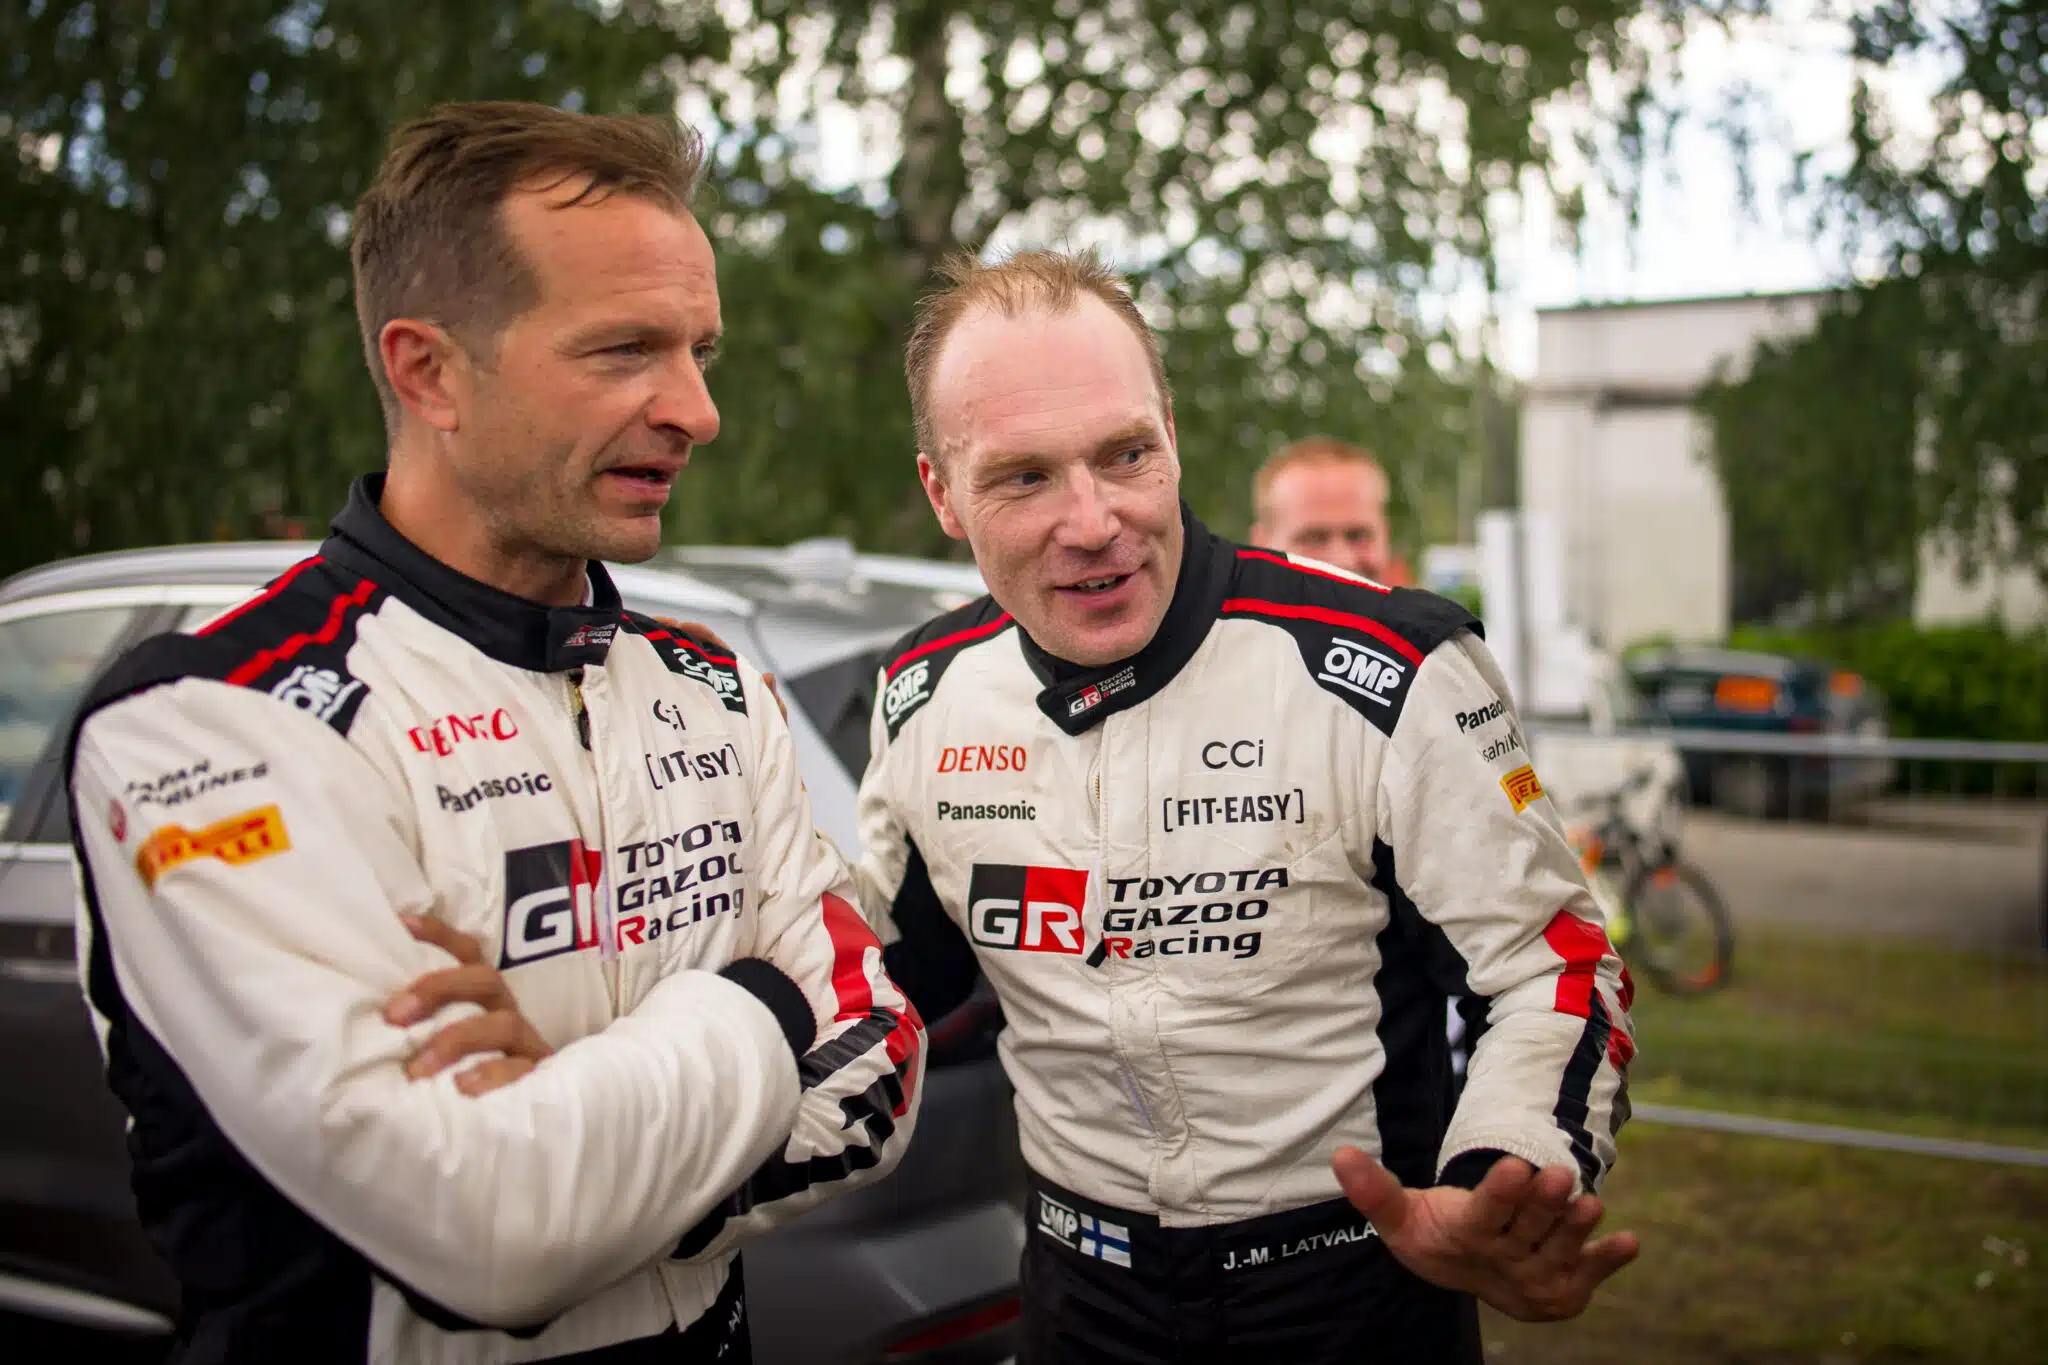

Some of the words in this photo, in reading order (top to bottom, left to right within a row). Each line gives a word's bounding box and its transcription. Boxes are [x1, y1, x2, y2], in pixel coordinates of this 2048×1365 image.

[1097, 665, 1135, 686] TOYOTA
[1101, 672, 1134, 692] GAZOO
[1324, 647, 1400, 694] OMP
[886, 668, 929, 715] OMP
[1070, 691, 1101, 714] GR
[1102, 679, 1136, 699] Racing
[937, 745, 1027, 772] DENSO
[1202, 739, 1264, 769] CCi
[938, 800, 1036, 821] Panasonic
[1106, 867, 1289, 903] TOYOTA
[617, 888, 745, 952] Racing
[1102, 899, 1269, 933] GAZOO
[1101, 929, 1262, 960] Racing
[1223, 1246, 1275, 1271] J.-M.
[1282, 1219, 1379, 1258] LATVALA
